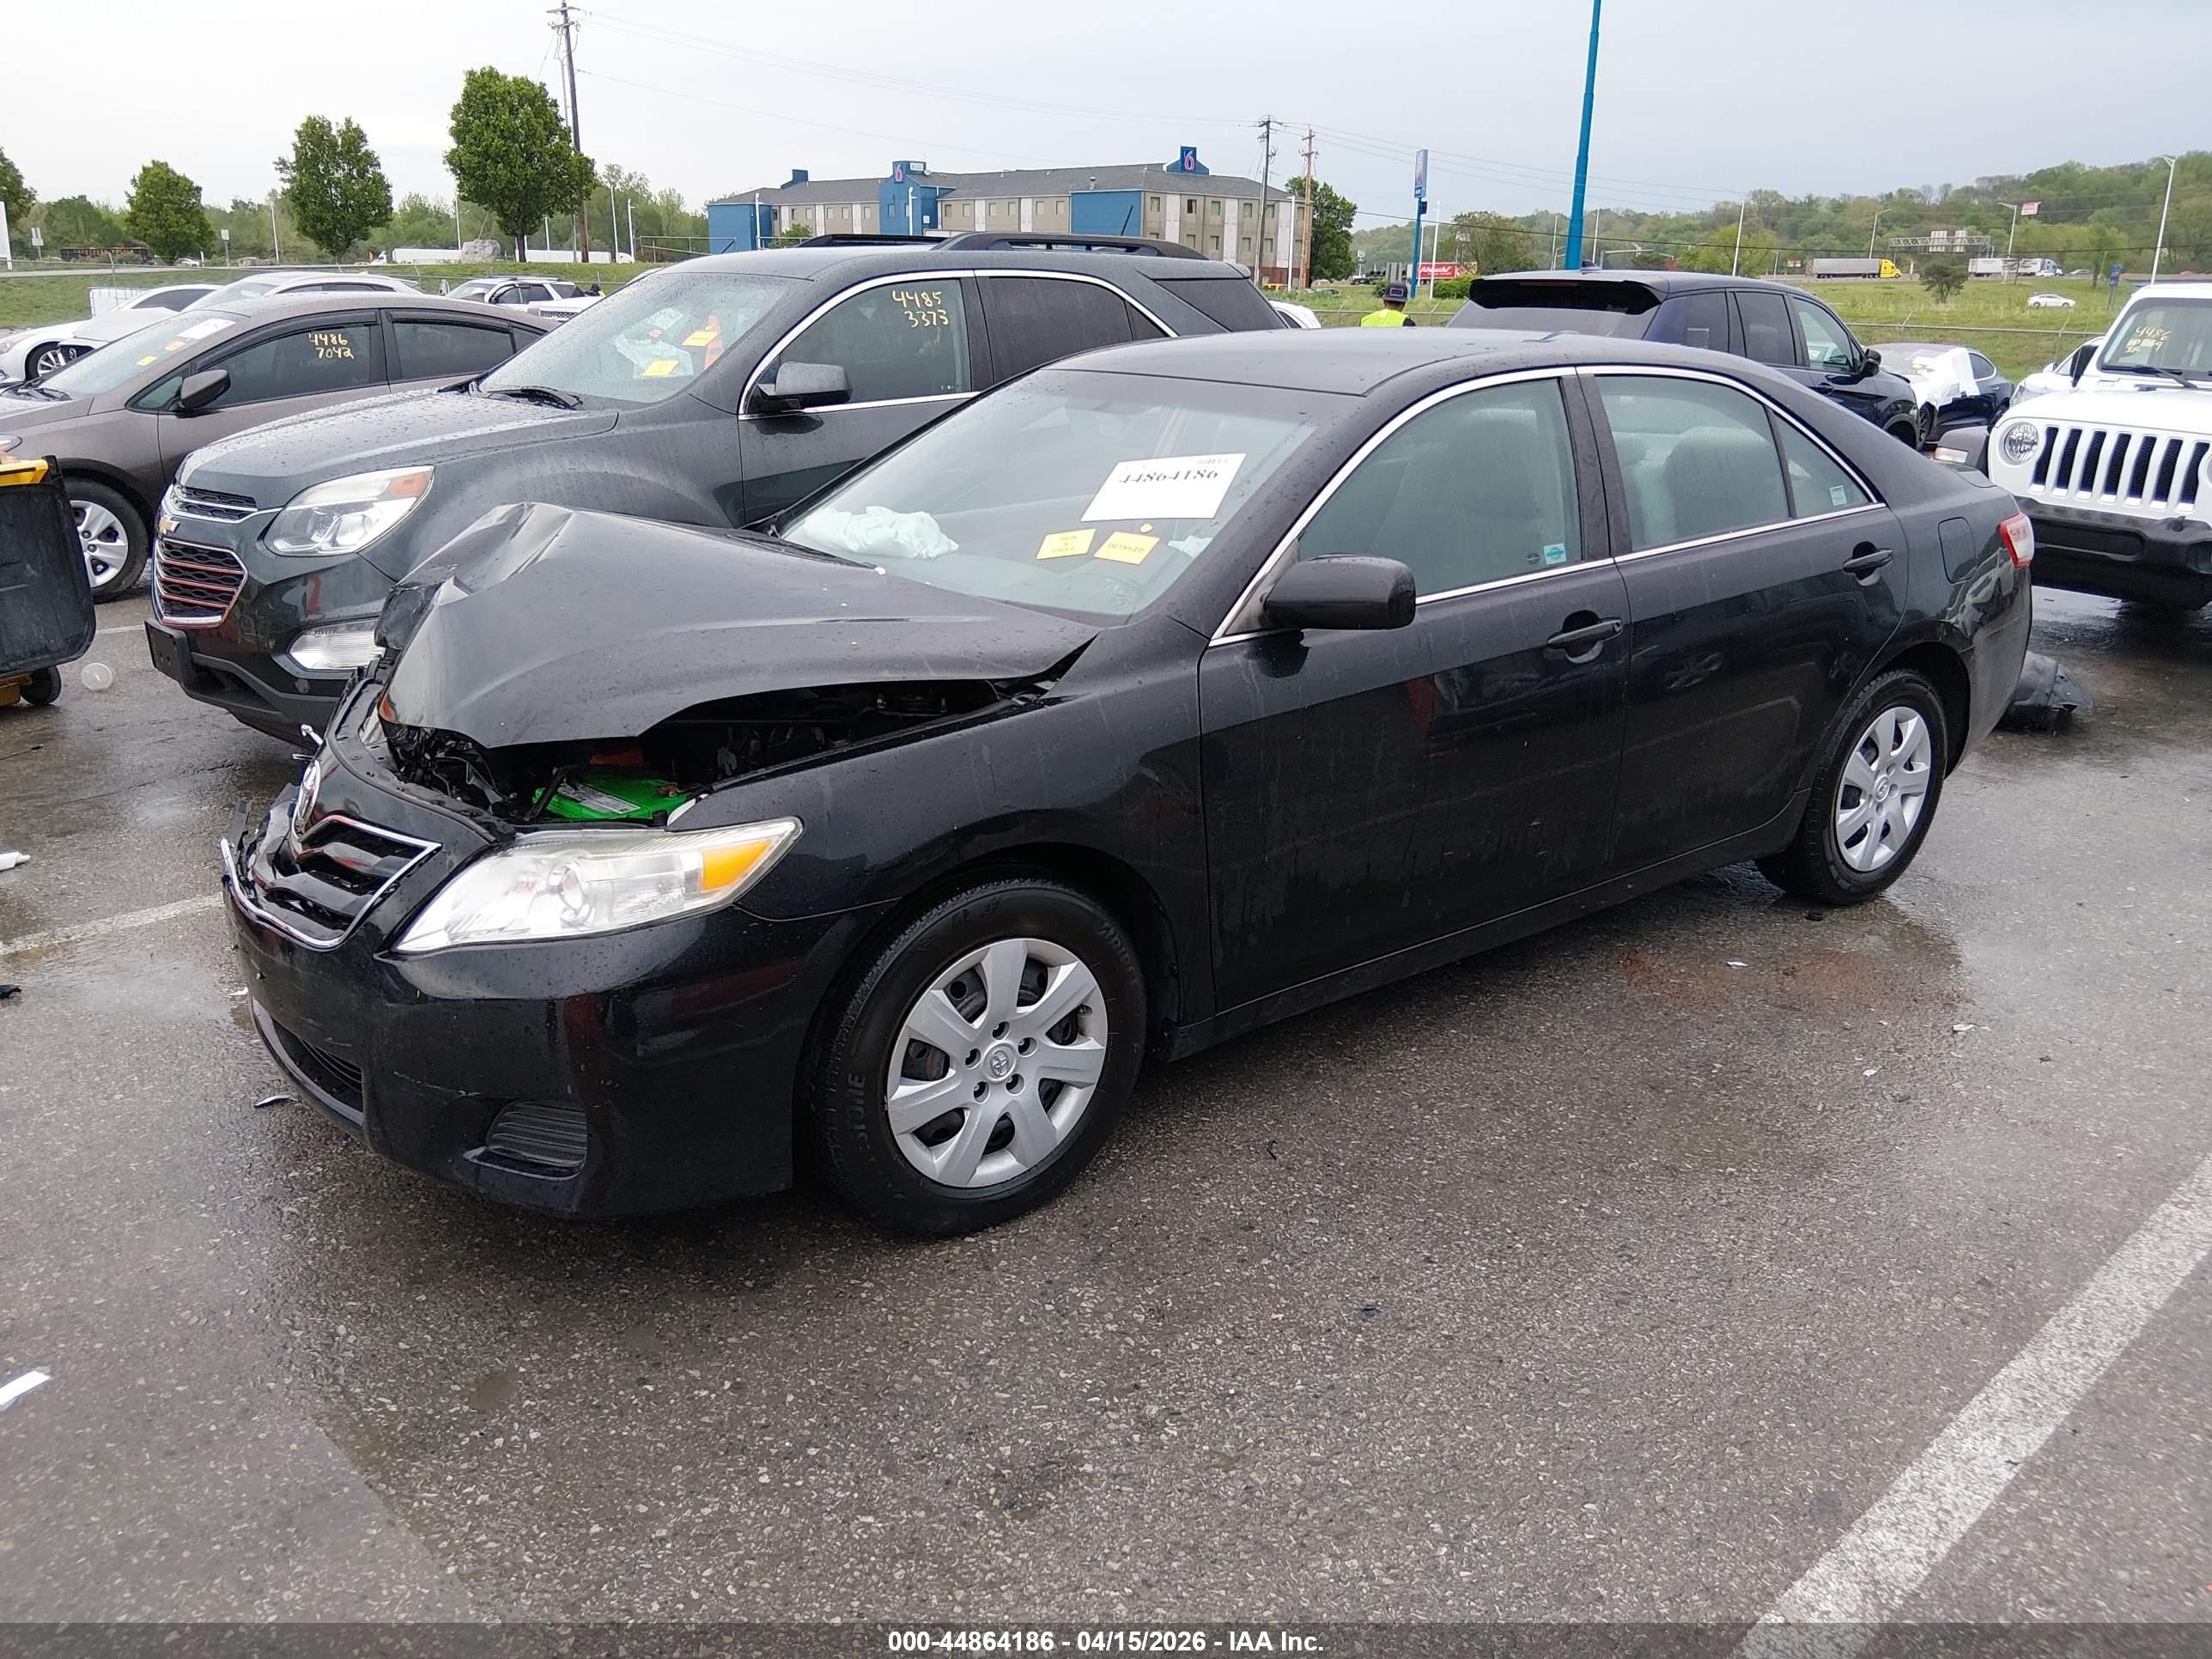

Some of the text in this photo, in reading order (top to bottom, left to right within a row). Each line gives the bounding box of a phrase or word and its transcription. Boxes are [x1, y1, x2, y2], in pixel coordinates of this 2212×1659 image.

[1184, 150, 1194, 171] 6
[895, 164, 902, 182] 6
[892, 290, 942, 308] 4485
[903, 309, 949, 327] 3373
[308, 333, 348, 345] 4486
[315, 346, 355, 359] 7042
[1119, 470, 1218, 483] 44864186
